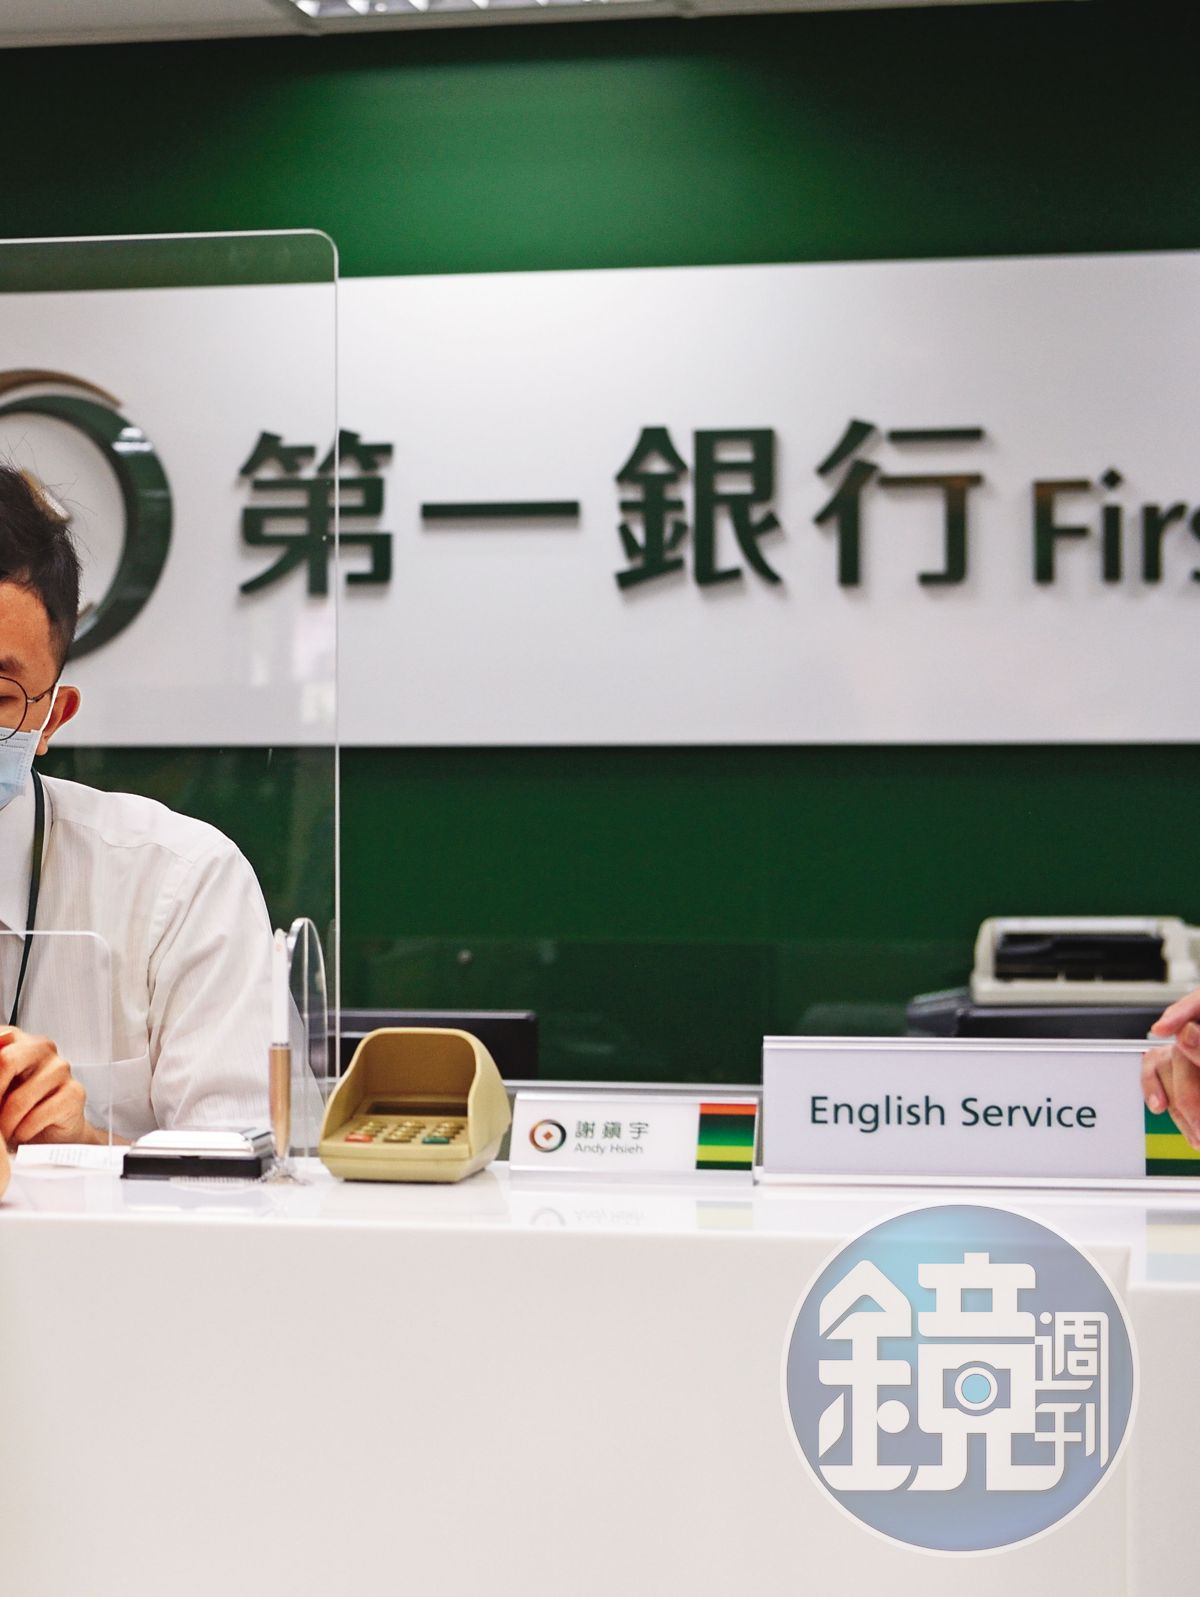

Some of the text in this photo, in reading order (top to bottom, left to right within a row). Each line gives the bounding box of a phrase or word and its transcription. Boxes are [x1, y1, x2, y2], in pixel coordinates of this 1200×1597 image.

[239, 419, 1200, 598] 第一銀行 Fir
[810, 1094, 1098, 1134] English Service
[574, 1142, 644, 1155] Andy Hsieh
